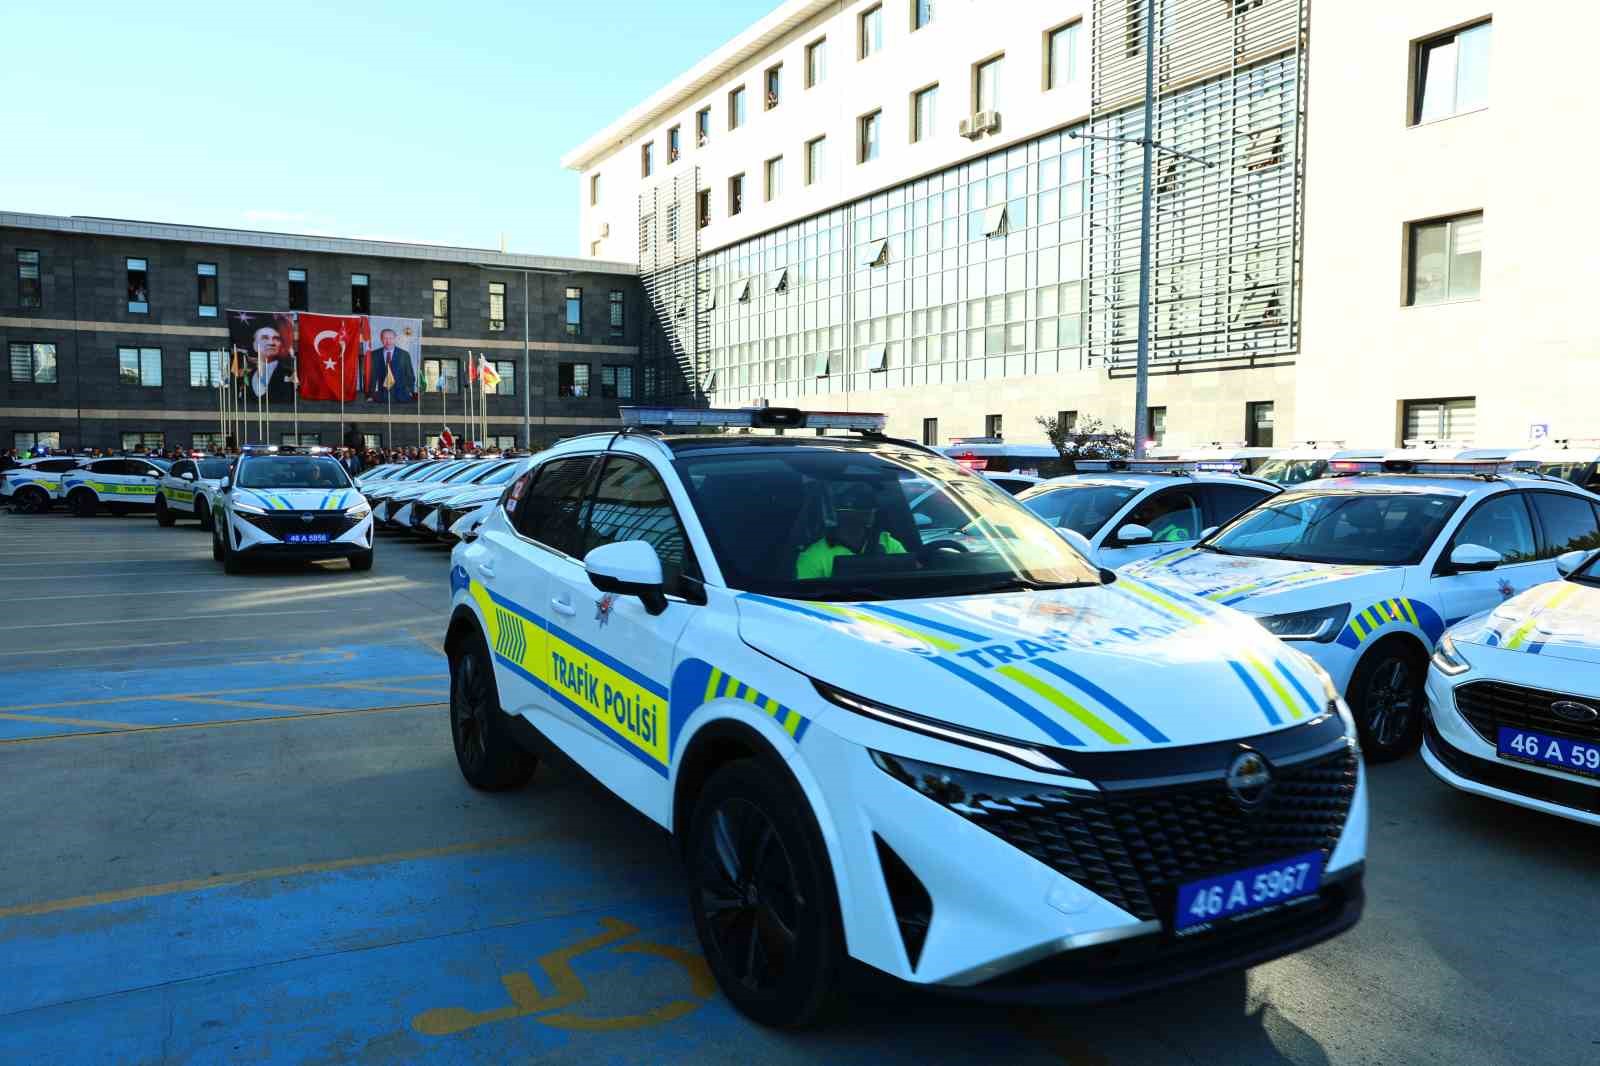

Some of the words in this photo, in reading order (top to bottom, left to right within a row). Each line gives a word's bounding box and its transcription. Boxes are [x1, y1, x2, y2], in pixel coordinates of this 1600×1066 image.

[552, 651, 599, 709] TRAFİK
[604, 683, 657, 747] POLİSİ
[1511, 734, 1538, 756] 46
[1545, 740, 1564, 762] A
[1190, 885, 1224, 917] 46
[1226, 879, 1248, 909] A
[1252, 862, 1311, 902] 5967
